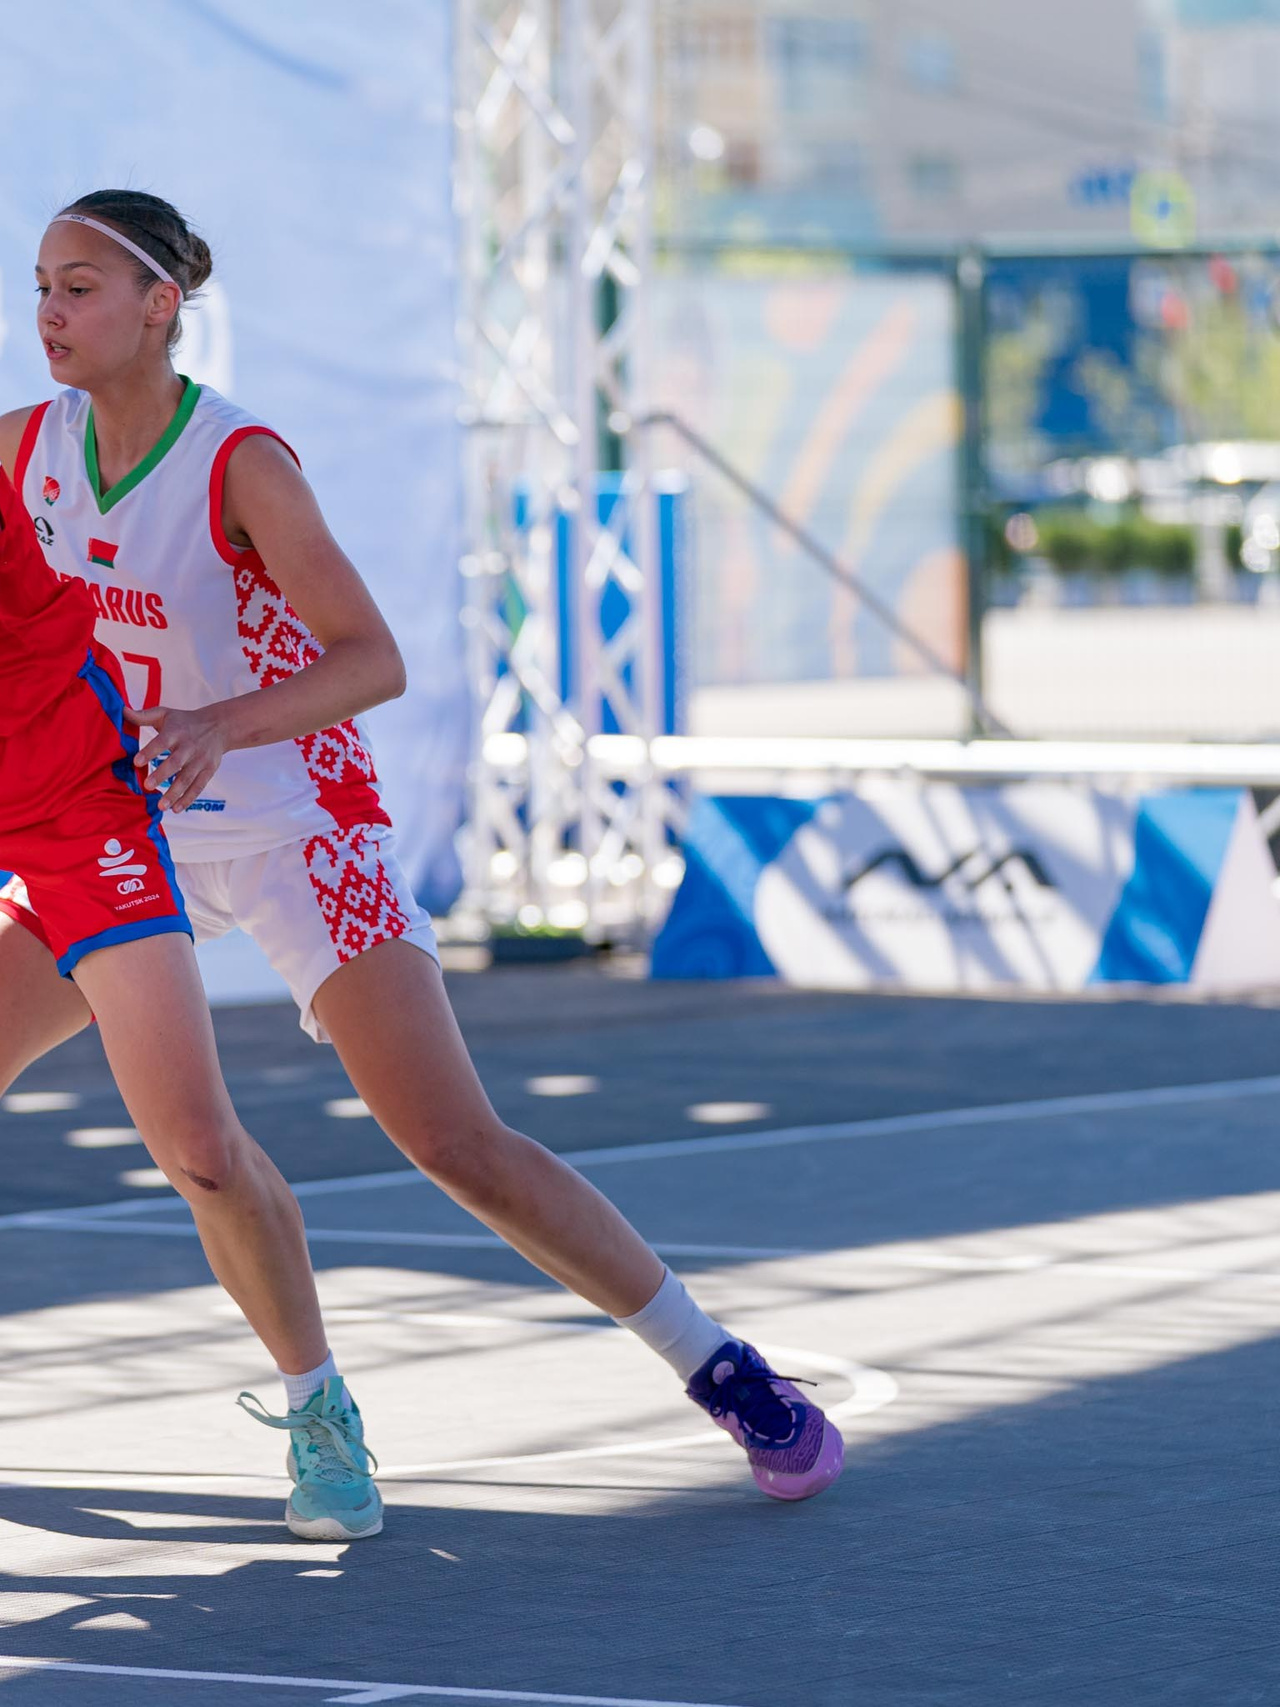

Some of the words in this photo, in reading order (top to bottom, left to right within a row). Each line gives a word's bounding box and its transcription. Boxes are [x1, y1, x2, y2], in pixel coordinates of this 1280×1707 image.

[86, 583, 168, 629] ARUS
[114, 898, 144, 911] YAKUTSK
[143, 893, 160, 902] 2024
